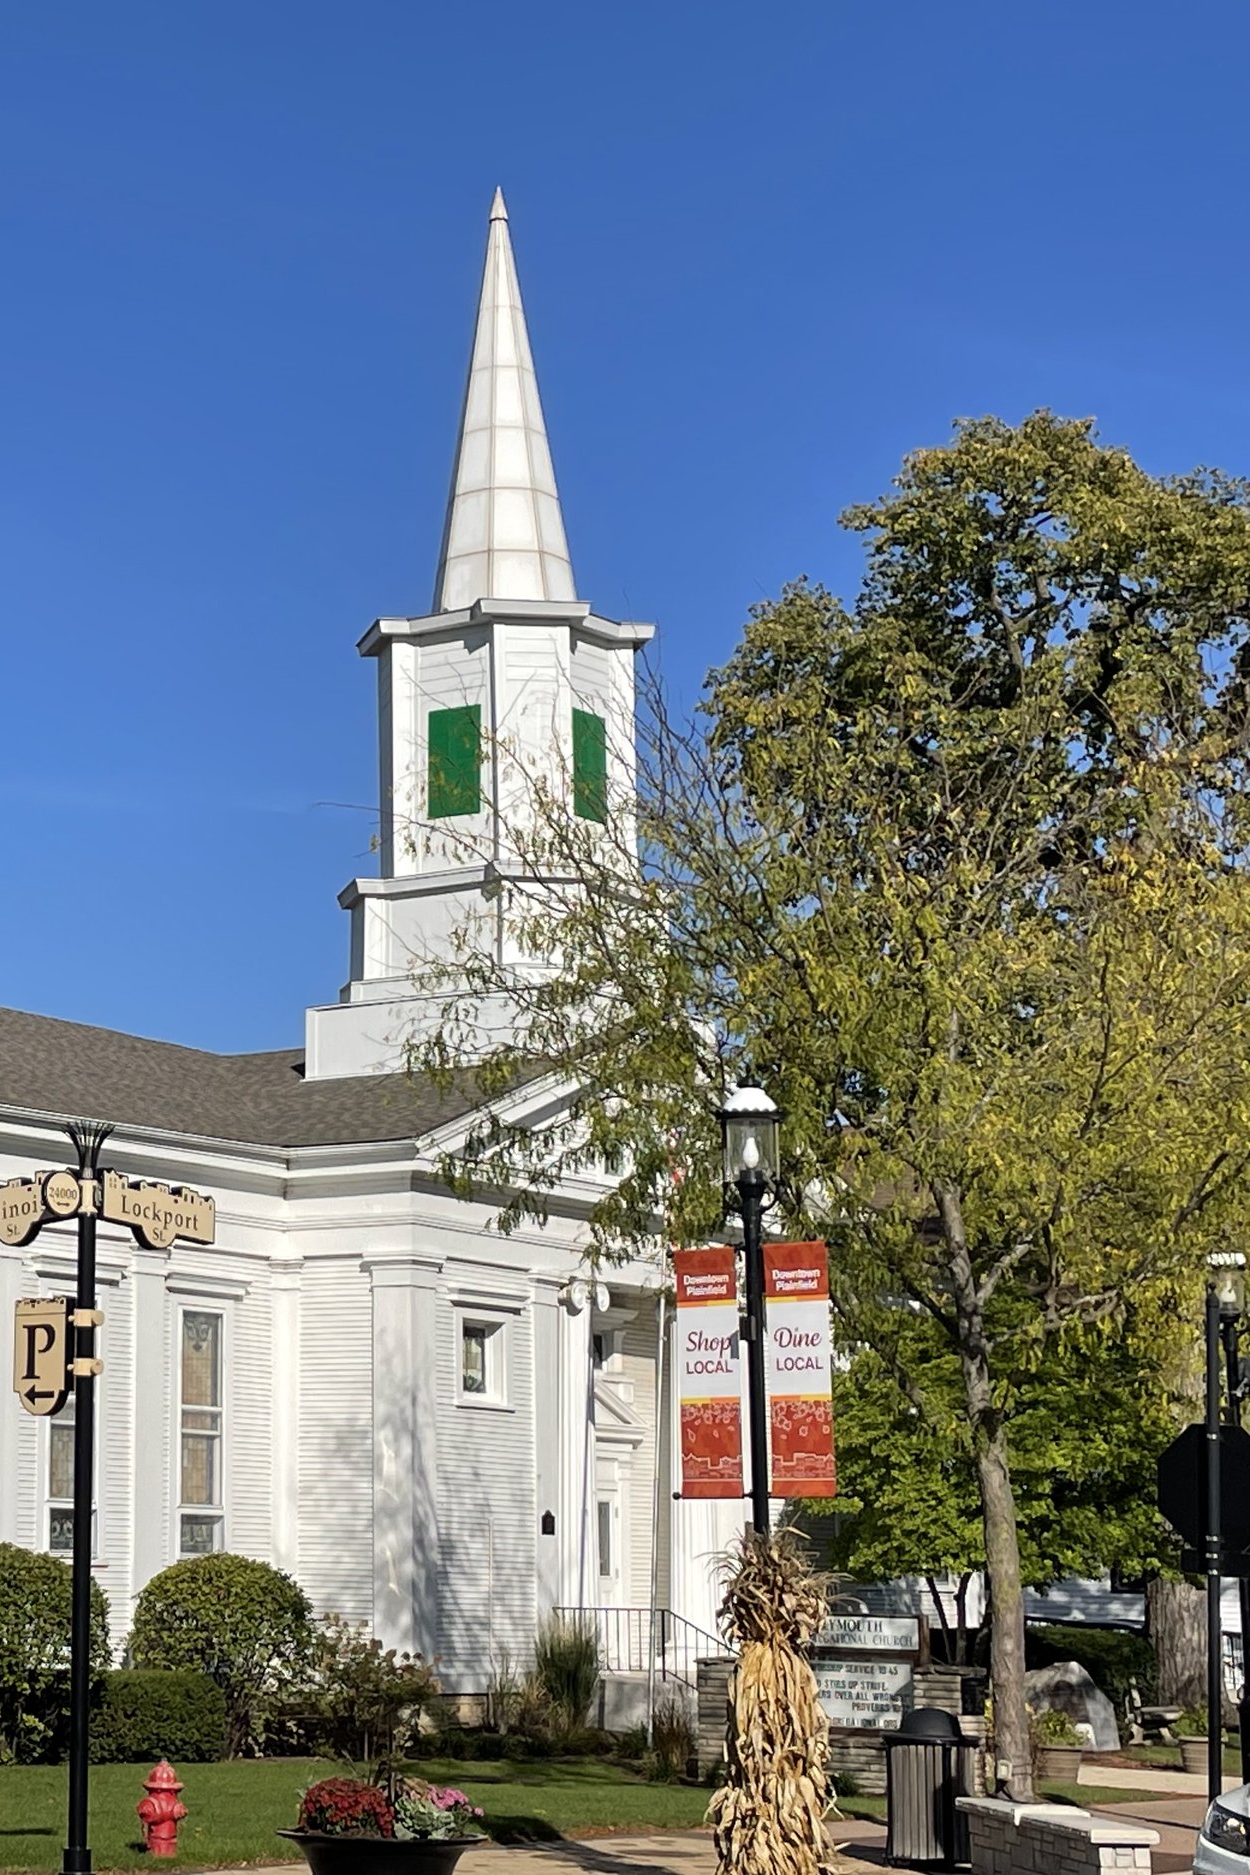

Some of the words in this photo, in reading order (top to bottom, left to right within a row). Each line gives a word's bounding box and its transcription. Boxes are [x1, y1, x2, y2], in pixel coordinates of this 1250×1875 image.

[121, 1194, 199, 1231] Lockport
[683, 1274, 730, 1286] Downtown
[772, 1268, 821, 1280] Downtown
[686, 1284, 728, 1296] Plainfield
[775, 1278, 819, 1291] Plainfield
[774, 1326, 822, 1348] Dine
[21, 1323, 56, 1380] P
[686, 1330, 731, 1359] Shop
[686, 1360, 733, 1375] LOCAL
[776, 1356, 824, 1371] LOCAL
[872, 1634, 913, 1648] CHURCH
[845, 1664, 875, 1675] SERVICE
[855, 1692, 869, 1700] ALL
